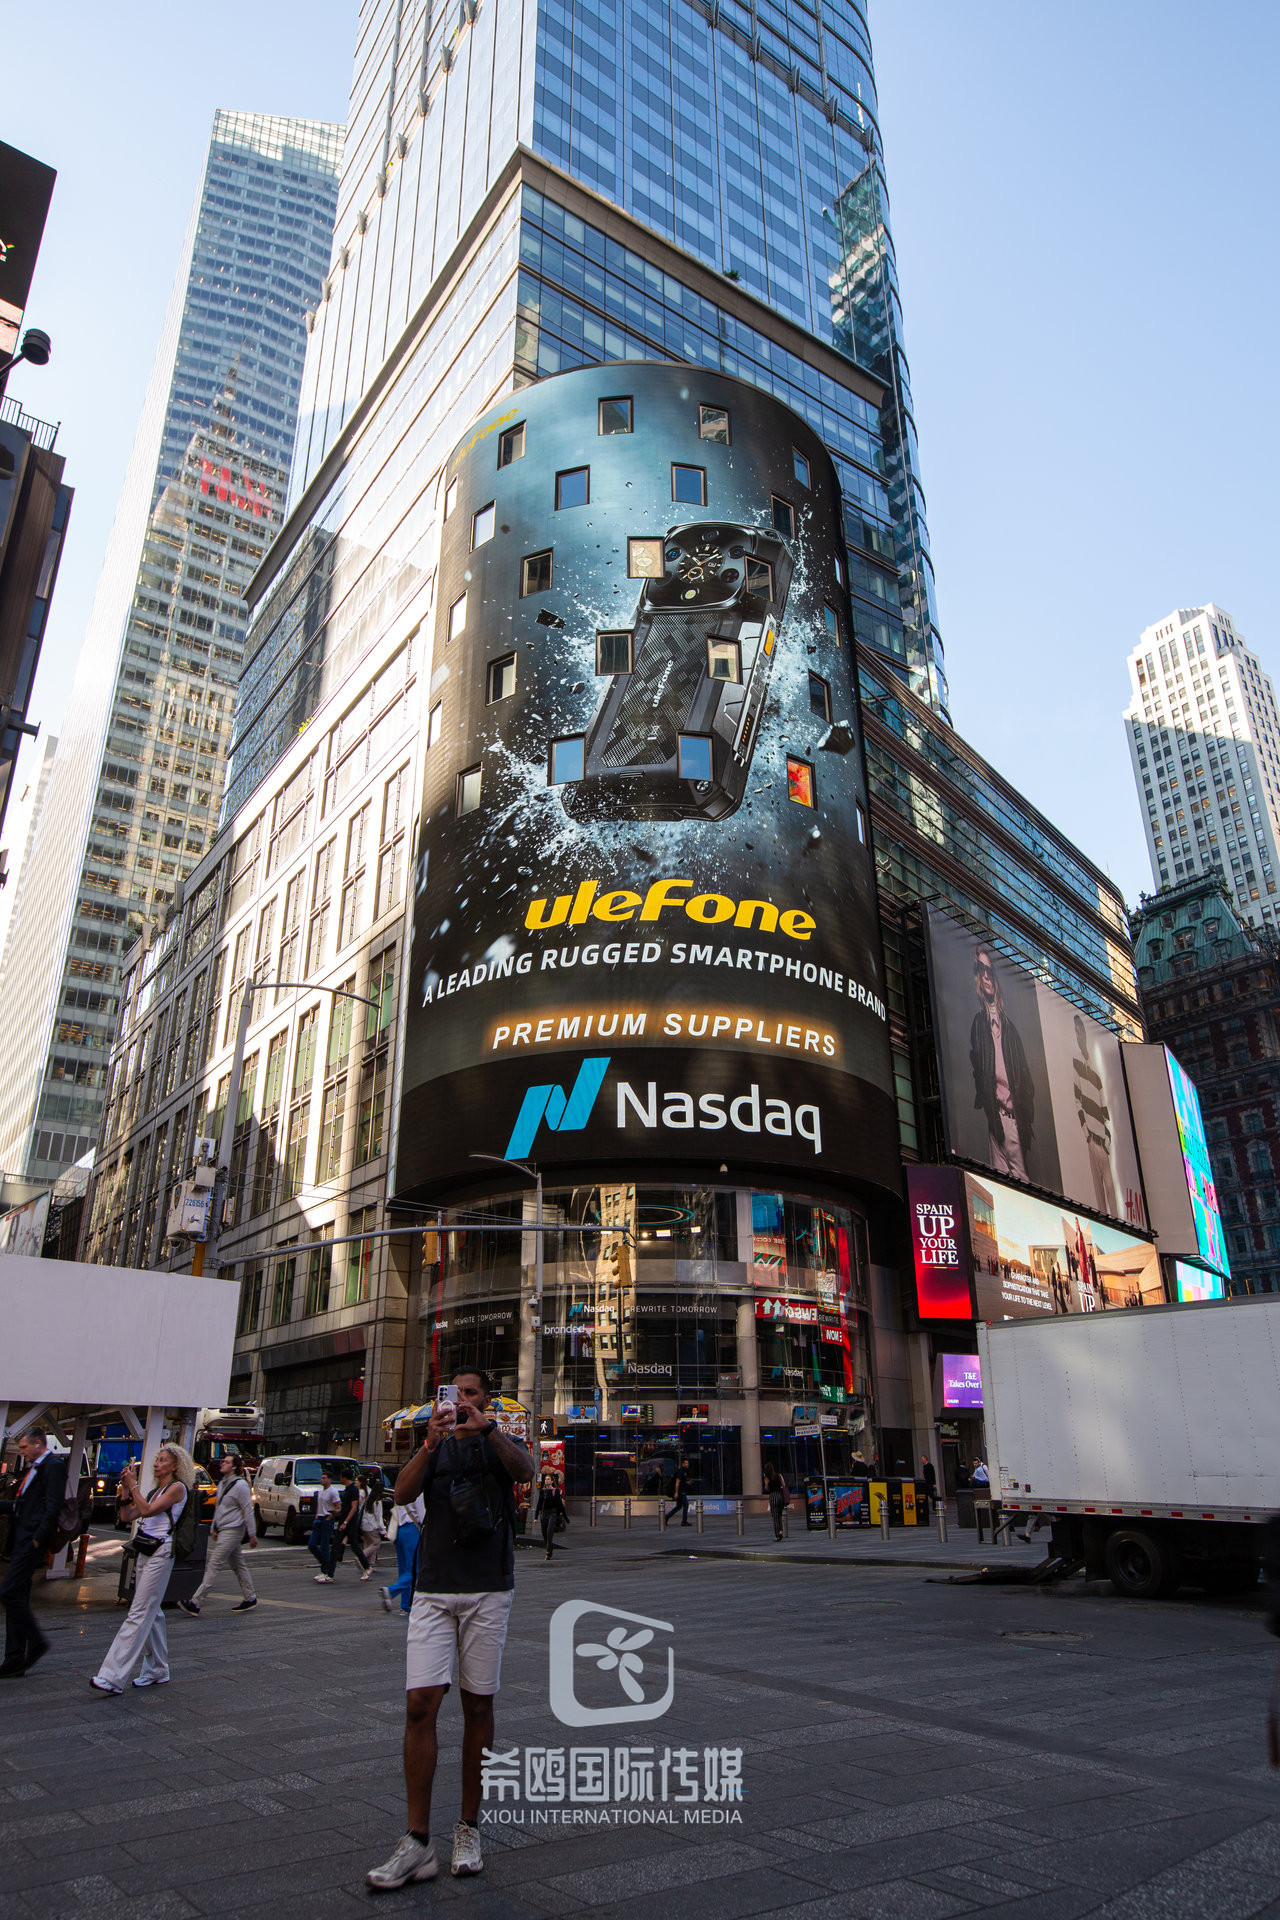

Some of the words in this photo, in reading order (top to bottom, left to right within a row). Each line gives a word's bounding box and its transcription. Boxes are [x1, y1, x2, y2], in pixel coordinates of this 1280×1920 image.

[422, 985, 433, 1008] A
[436, 952, 533, 1000] LEADING
[541, 941, 662, 969] RUGGED
[670, 943, 844, 993] SMARTPHONE
[848, 977, 887, 1022] BRAND
[492, 1012, 647, 1049] PREMIUM
[663, 1013, 837, 1056] SUPPLIERS
[616, 1081, 822, 1155] Nasdaq
[916, 1203, 953, 1216] SPAIN
[1125, 1187, 1145, 1228] H&M
[917, 1215, 955, 1238] UP
[919, 1237, 957, 1250] YOUR
[920, 1249, 959, 1265] LIFE
[583, 1304, 615, 1314] Nasdaq
[631, 1304, 667, 1313] REWRITE
[671, 1305, 718, 1314] TOMORROW
[1079, 1292, 1095, 1312] UP
[477, 1312, 513, 1322] TOMORROW
[628, 1362, 672, 1376] Nasdaq
[964, 1372, 978, 1380] T&E
[948, 1379, 965, 1388] Takes
[966, 1380, 979, 1388] Over
